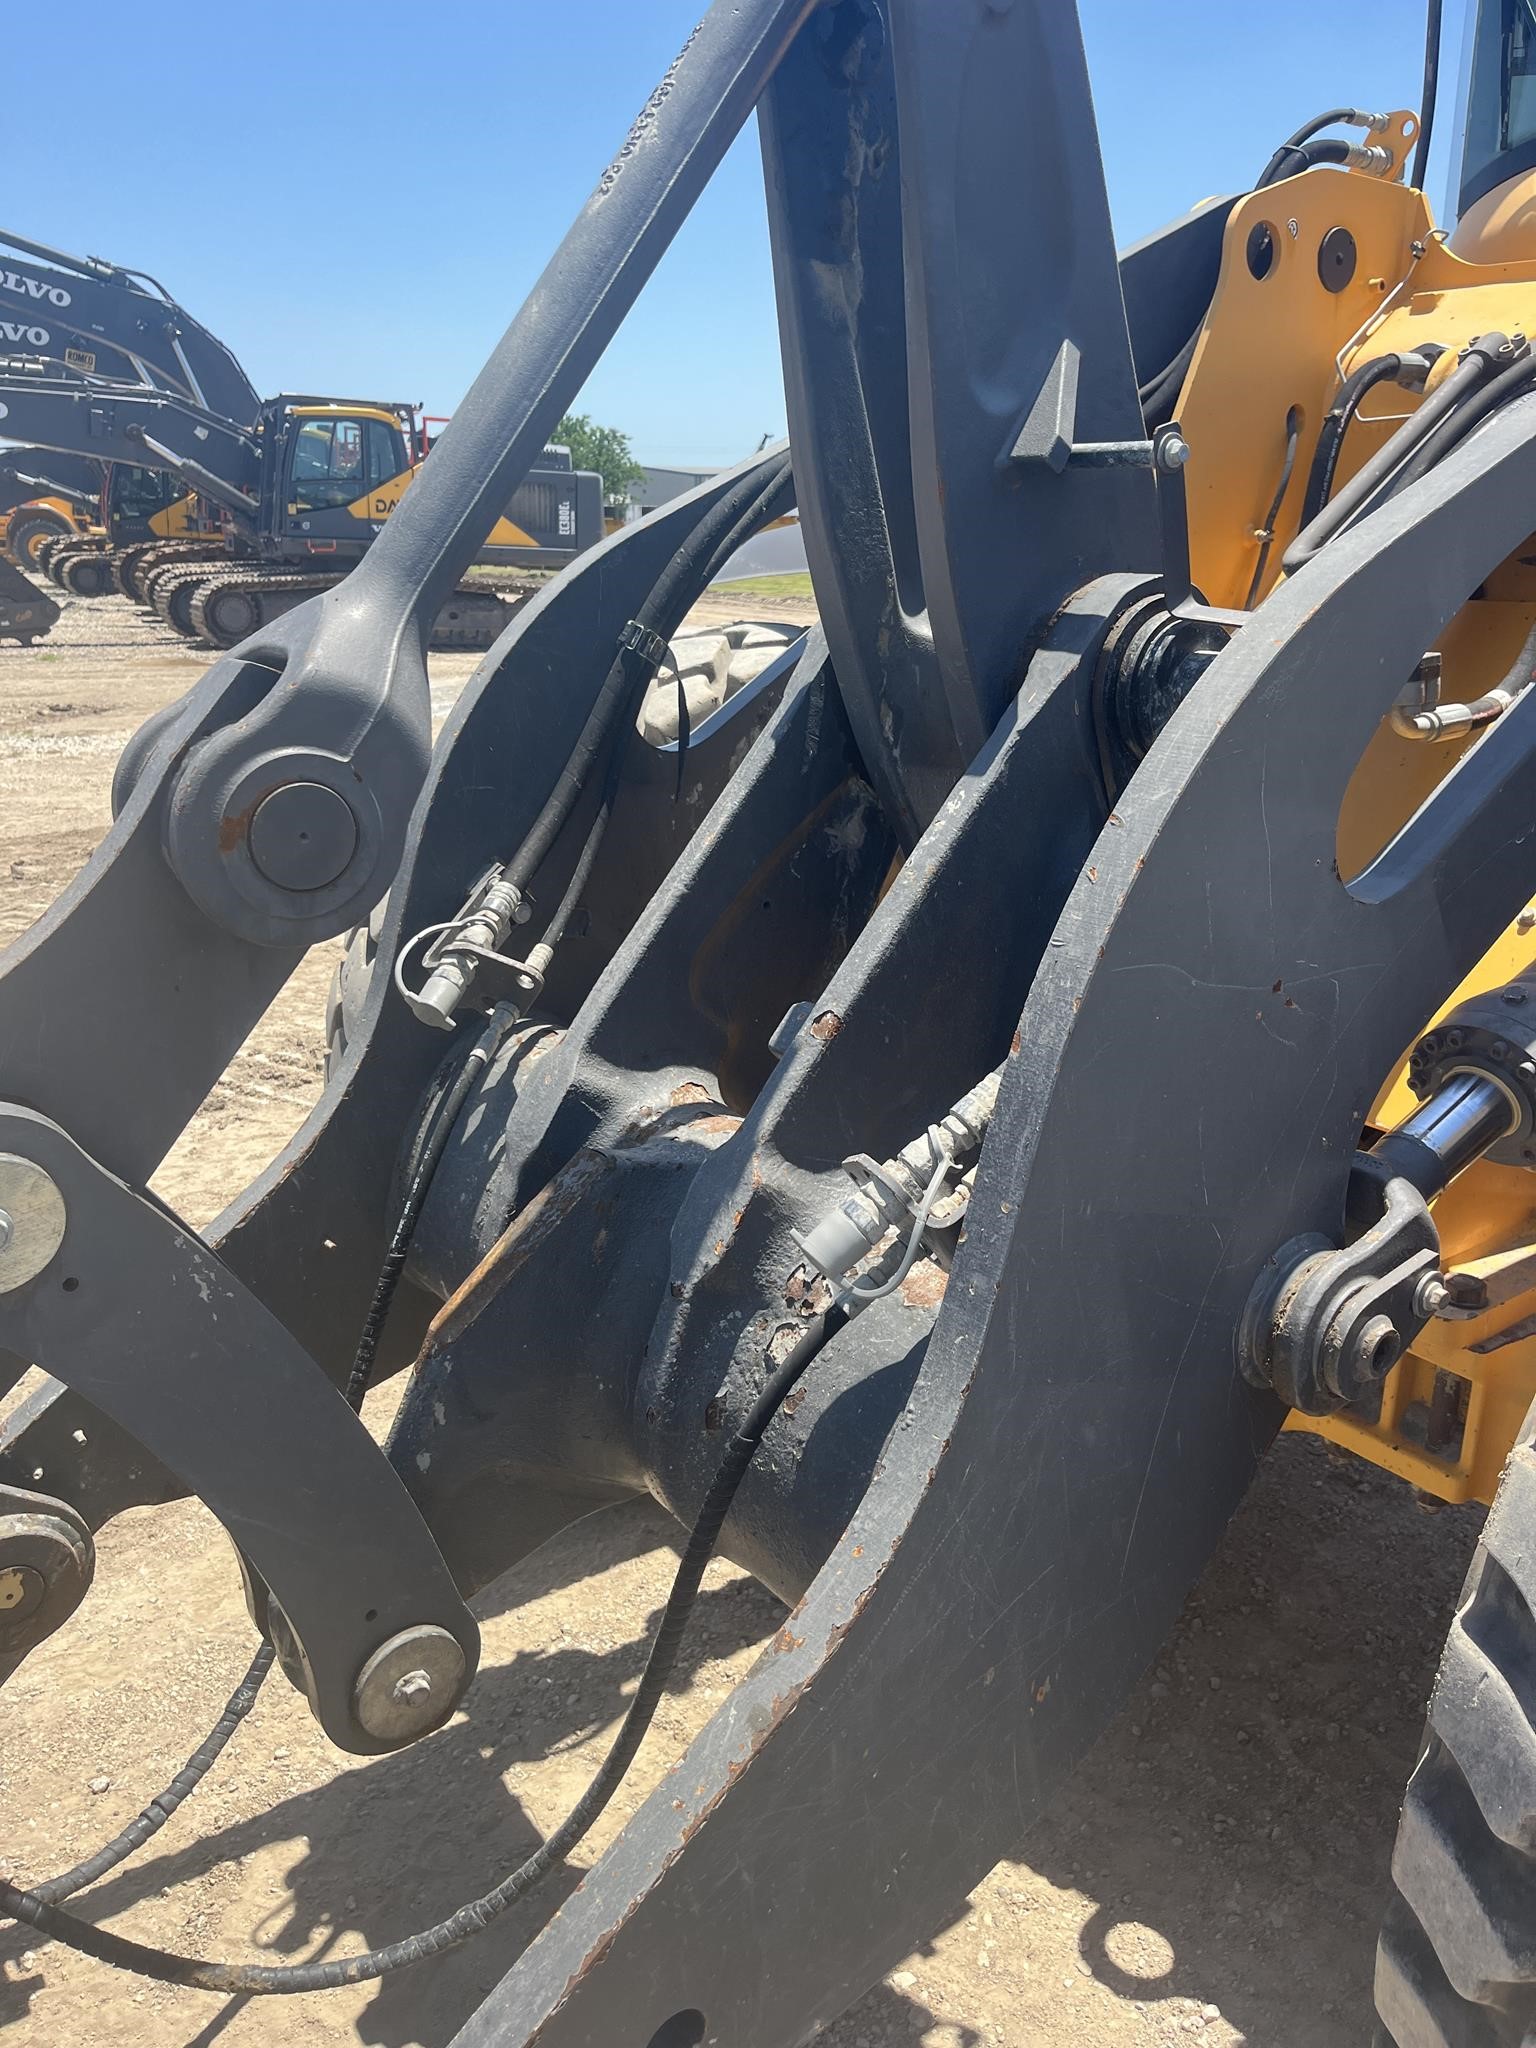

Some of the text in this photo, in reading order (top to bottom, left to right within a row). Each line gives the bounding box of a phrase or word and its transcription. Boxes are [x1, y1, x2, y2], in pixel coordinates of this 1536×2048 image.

[0, 270, 71, 307] LVO
[0, 321, 50, 346] VO
[376, 499, 400, 513] DA
